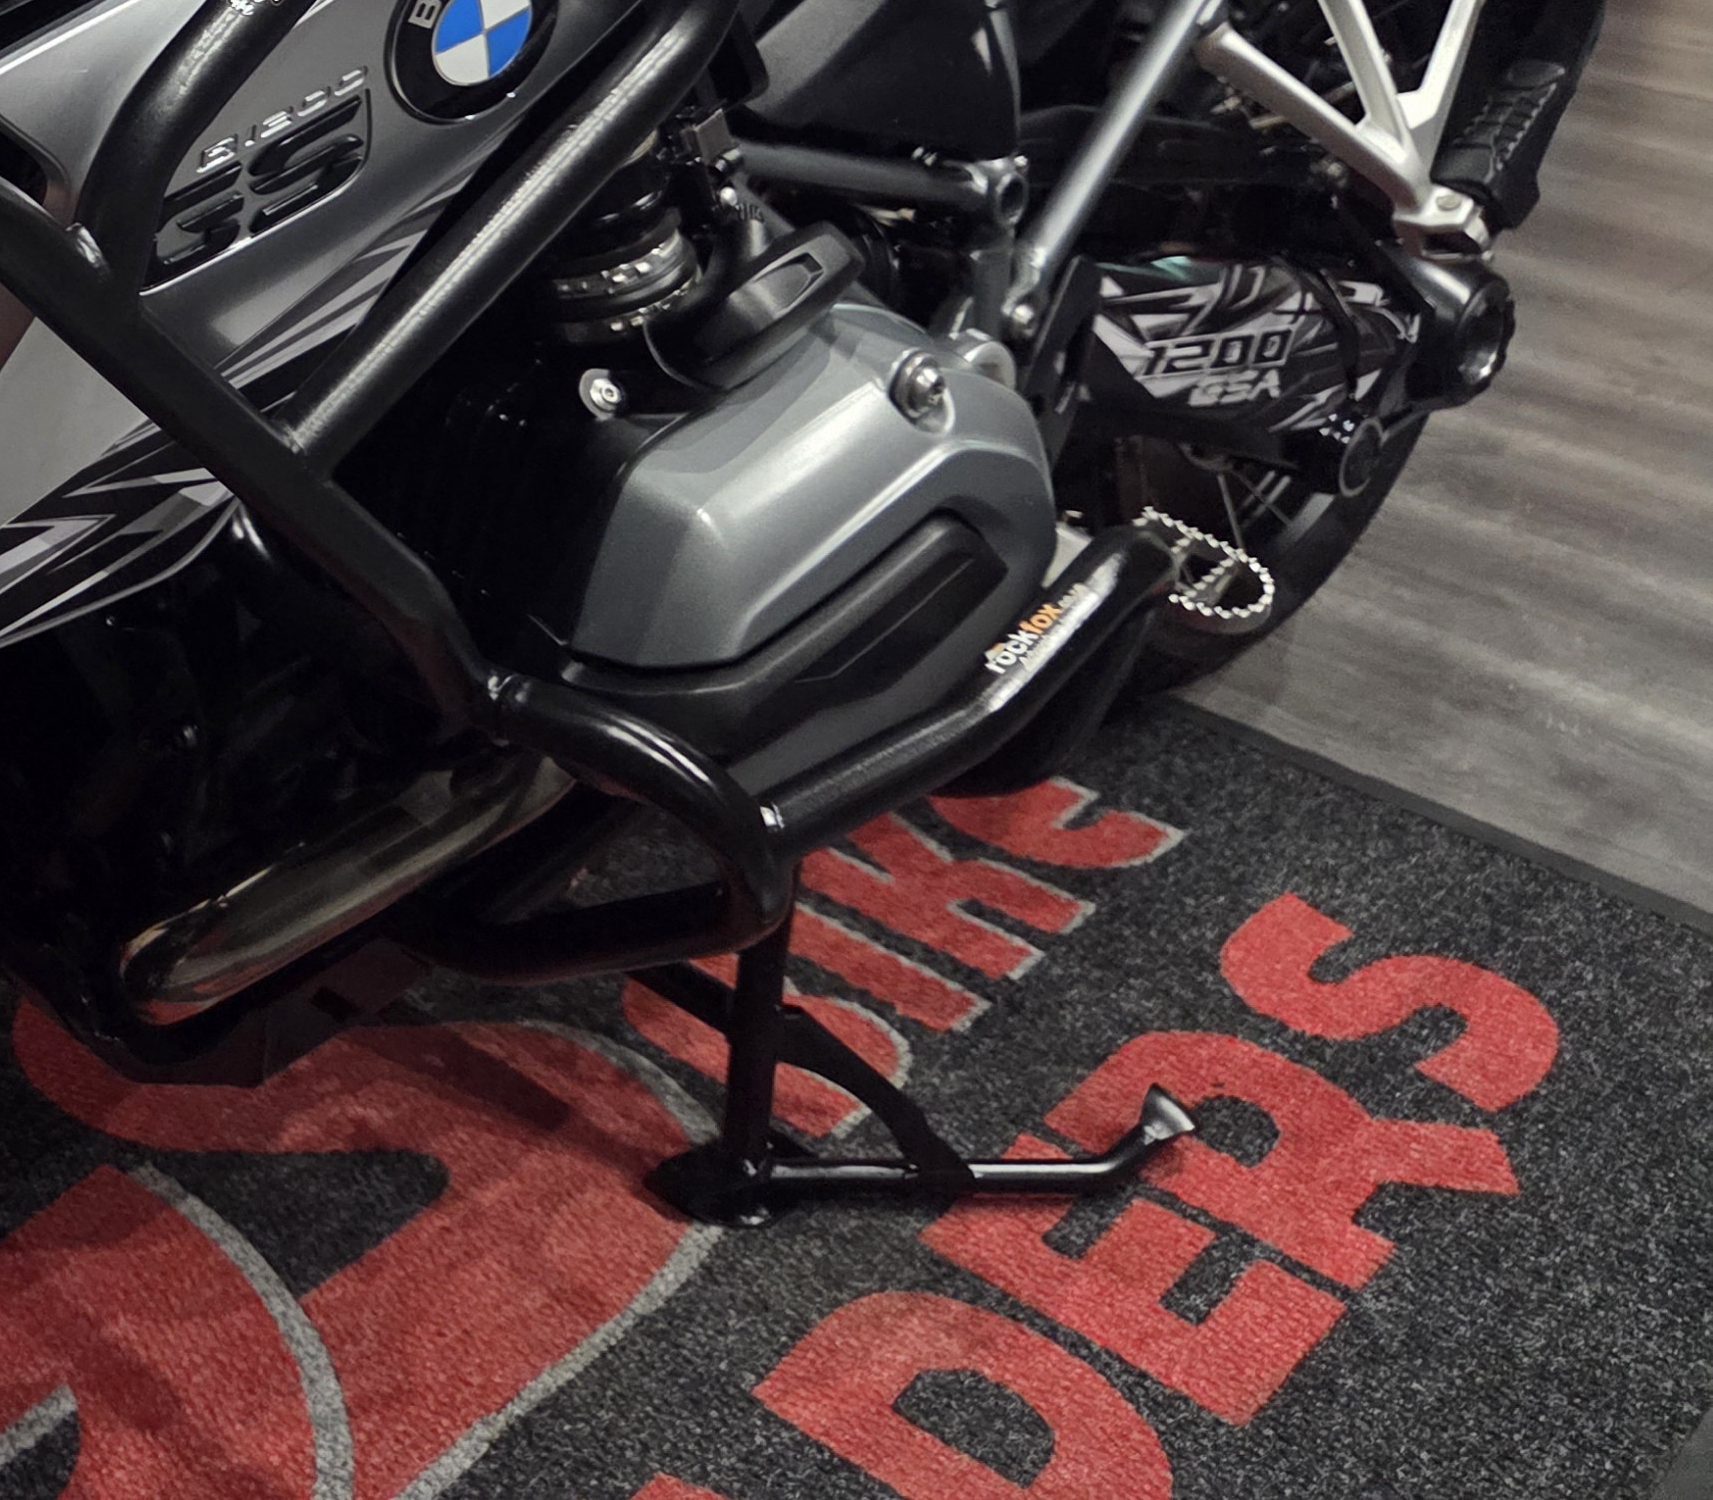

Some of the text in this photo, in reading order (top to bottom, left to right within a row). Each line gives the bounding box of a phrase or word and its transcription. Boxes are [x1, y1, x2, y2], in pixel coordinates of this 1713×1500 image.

[1141, 326, 1295, 380] 1200
[1188, 368, 1281, 408] GSA
[622, 891, 1559, 1500] DERS
